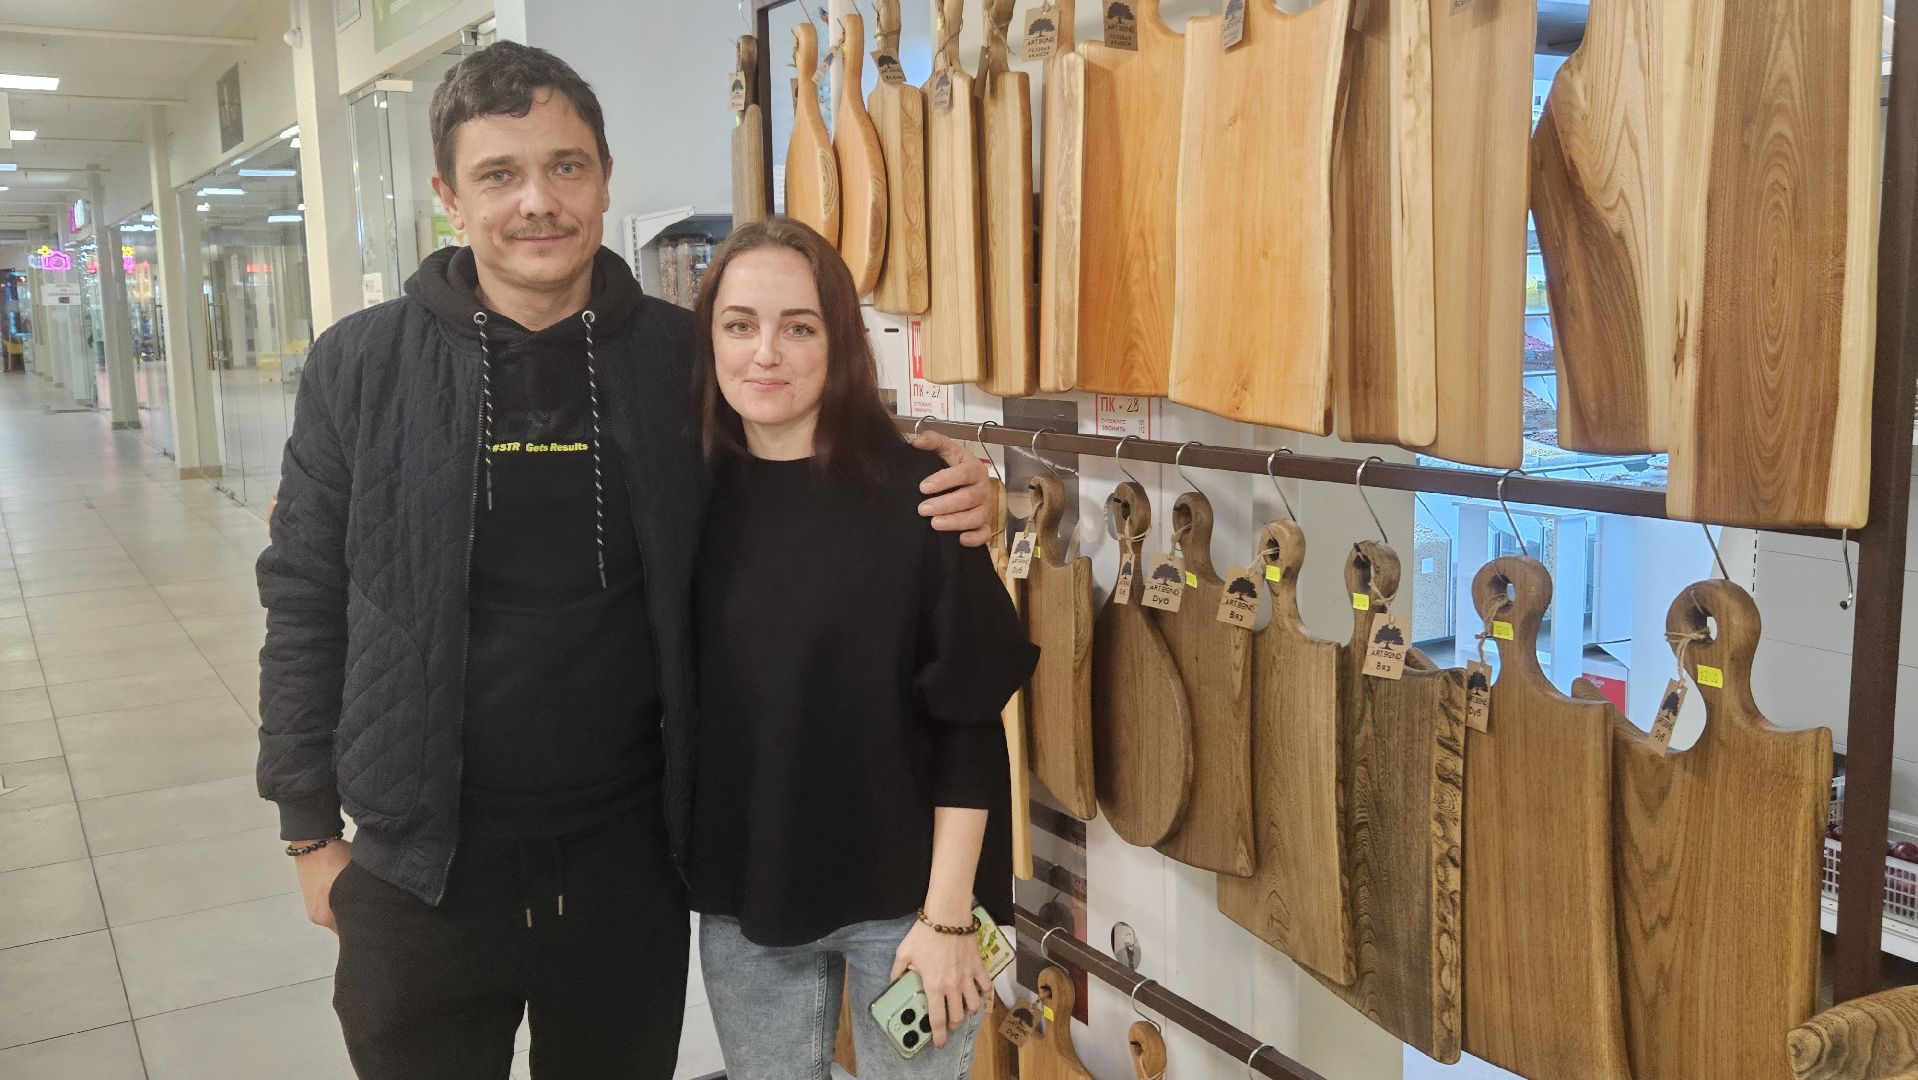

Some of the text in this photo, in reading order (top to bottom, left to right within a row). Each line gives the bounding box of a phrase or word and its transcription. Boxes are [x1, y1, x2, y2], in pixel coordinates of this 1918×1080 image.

[913, 383, 924, 397] ПК
[1101, 396, 1116, 412] ПК
[1126, 397, 1139, 413] 28
[525, 442, 549, 453] Gets
[549, 442, 589, 452] Results
